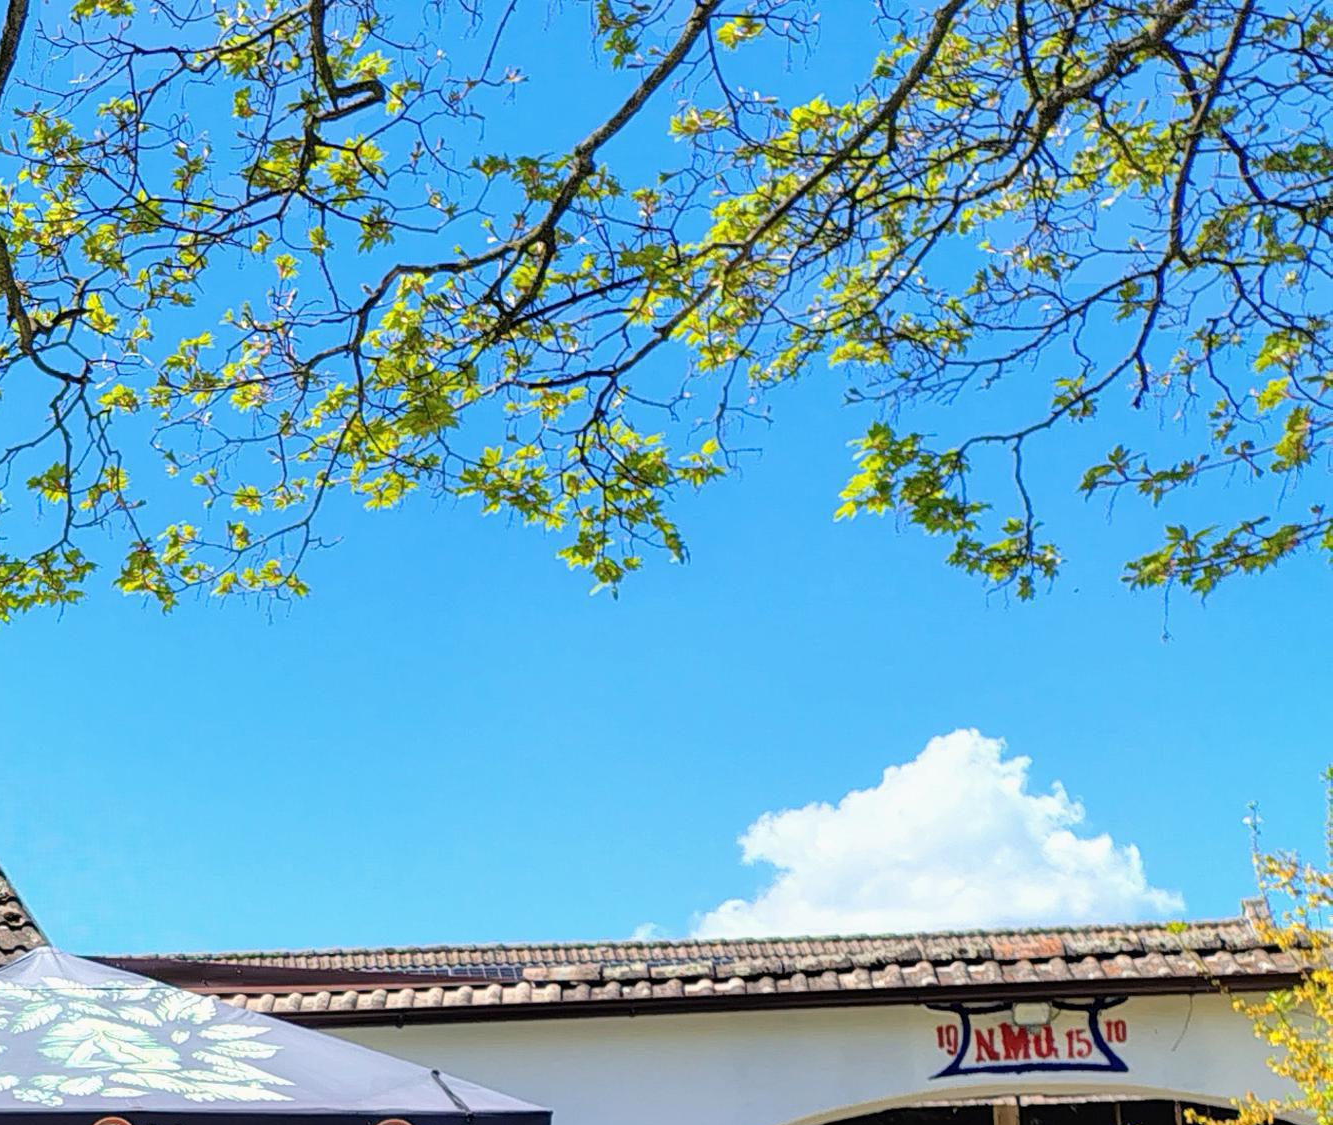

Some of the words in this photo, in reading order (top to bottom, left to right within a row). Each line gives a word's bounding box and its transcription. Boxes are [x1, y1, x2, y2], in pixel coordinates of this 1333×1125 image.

[936, 1023, 959, 1056] 19
[1065, 1028, 1093, 1059] 15
[1103, 1019, 1127, 1043] 10
